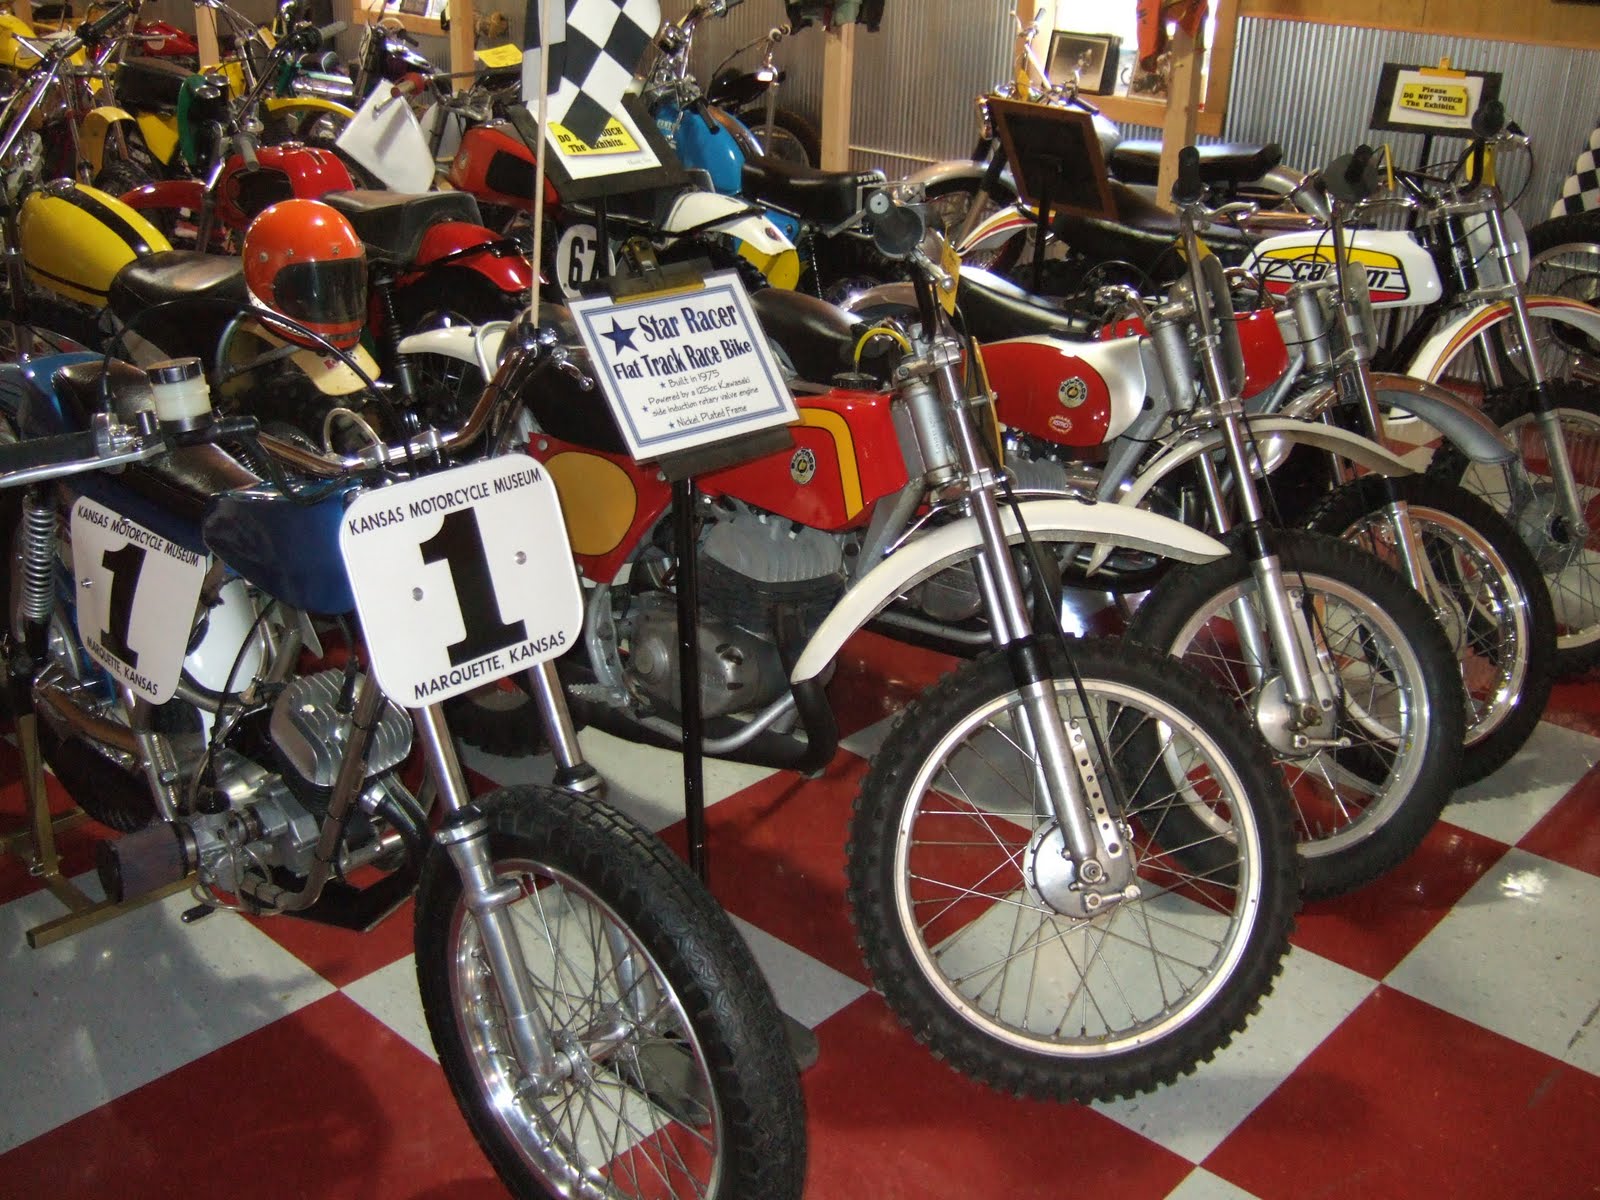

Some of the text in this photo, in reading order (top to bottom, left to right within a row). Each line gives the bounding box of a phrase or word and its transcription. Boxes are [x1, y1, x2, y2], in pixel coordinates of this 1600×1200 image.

[1422, 86, 1447, 94] Please
[568, 139, 626, 152] The xhibits.
[638, 305, 737, 342] Star Racer
[613, 339, 752, 380] Flat Track Race Bike
[668, 369, 720, 388] Built in 1975
[648, 392, 680, 405] Powered
[682, 391, 689, 400] by
[696, 385, 718, 395] 125cc
[718, 376, 751, 389] Kawasaki
[652, 387, 759, 417] side induction rotary valve engine
[677, 405, 747, 428] Nickel Plated Frame
[349, 467, 542, 536] KANSAS MOTORCYCLE MUSEUM
[78, 505, 199, 567] KANSAS MOTORCYCLE MUSEUM
[101, 542, 147, 670] 1
[419, 506, 528, 667] 1
[87, 636, 158, 695] MARQUETTE, KANSAS
[414, 631, 566, 700] MARQUETTE, KANSAS
